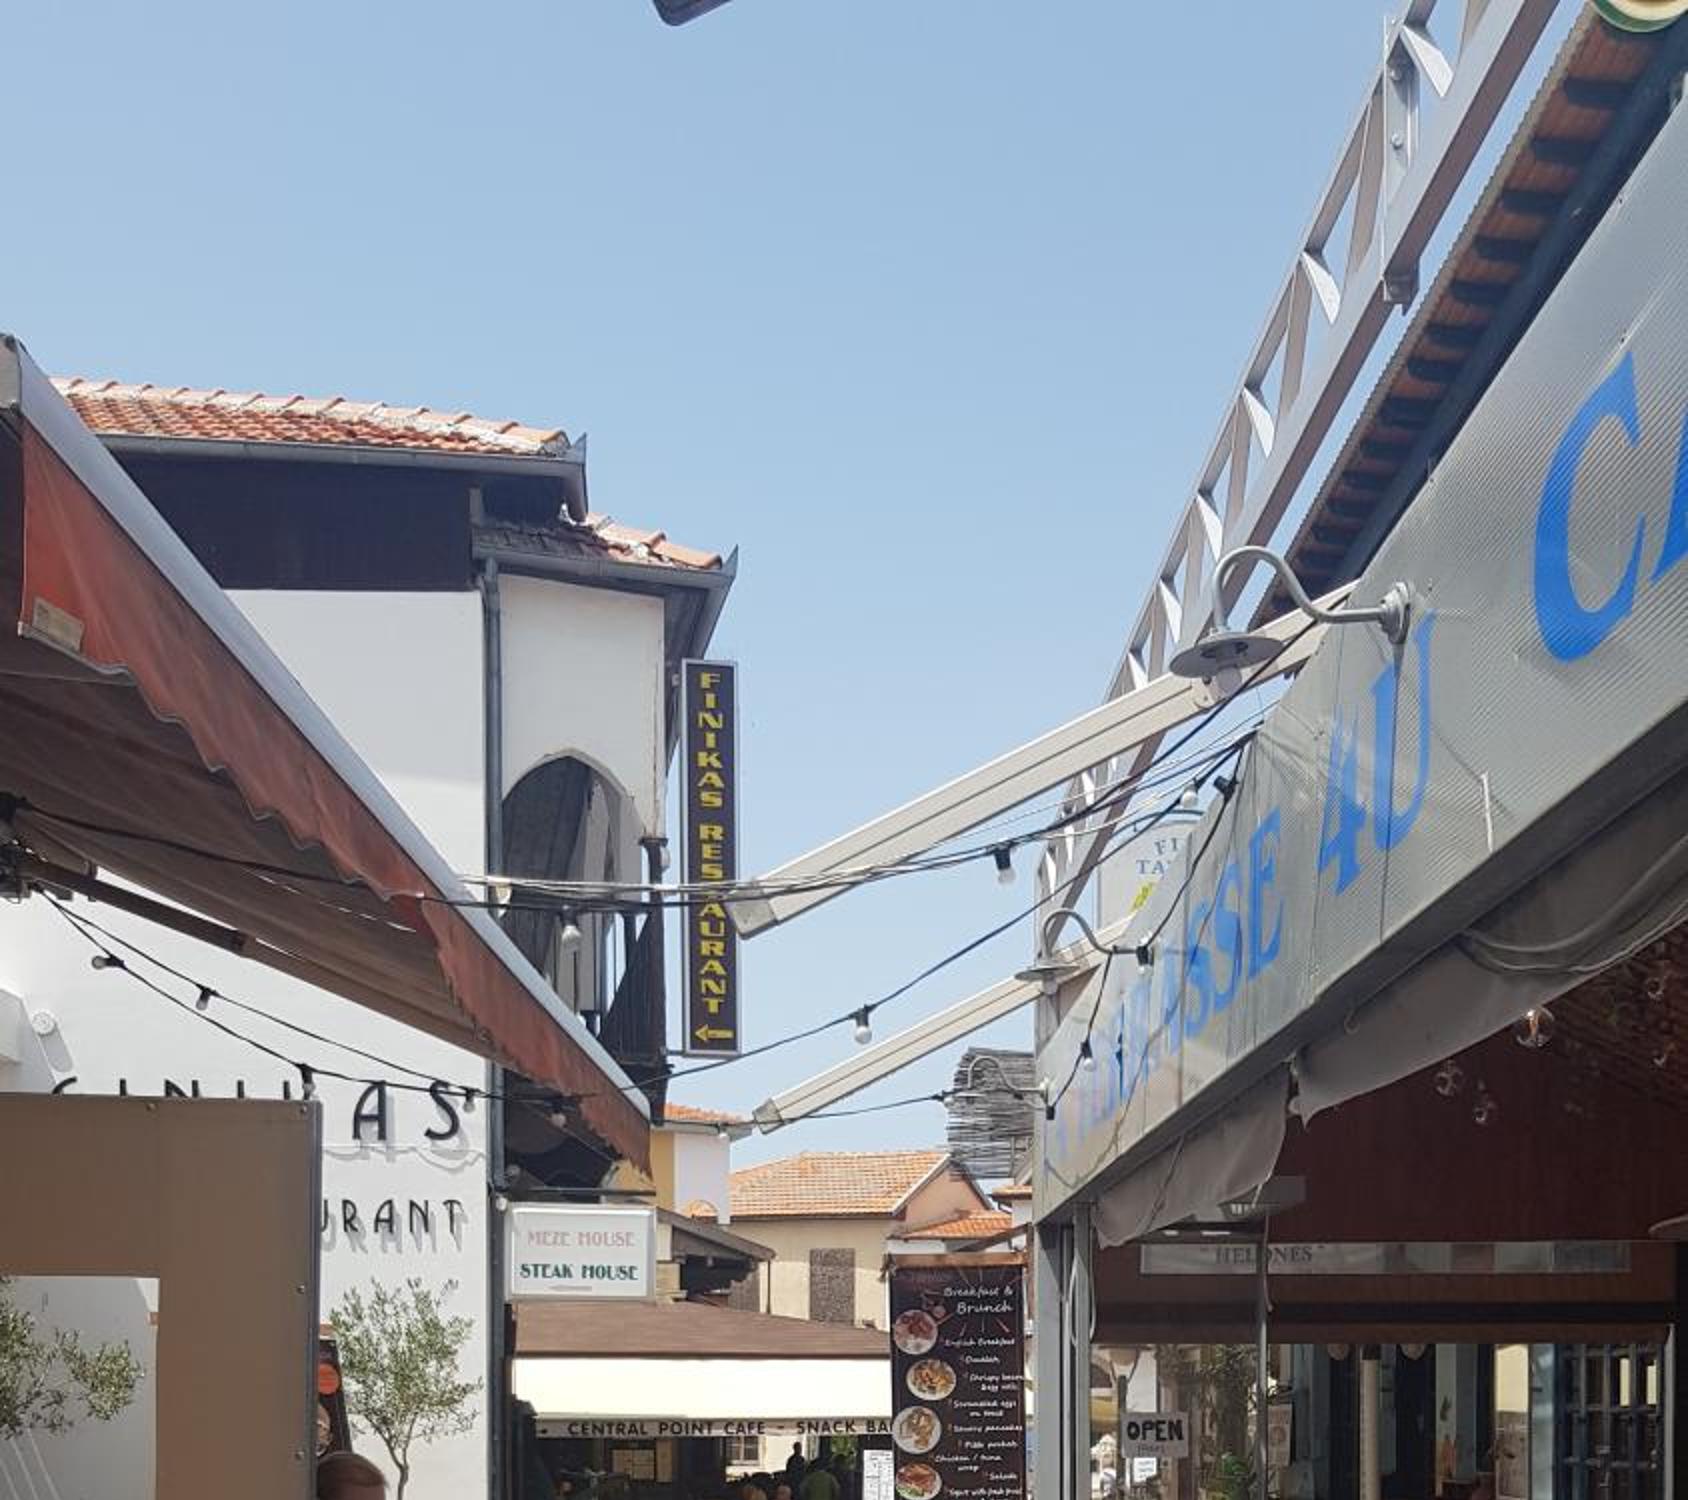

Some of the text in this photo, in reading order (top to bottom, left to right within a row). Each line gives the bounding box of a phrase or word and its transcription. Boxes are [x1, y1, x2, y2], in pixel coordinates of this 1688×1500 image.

[1316, 608, 1438, 896] 4U
[696, 671, 726, 1014] FINIKAS RESAURANT
[1136, 859, 1171, 876] TA
[528, 1231, 636, 1247] MEZE HOUSE
[520, 1263, 639, 1280] STEAK HOUSE
[943, 1285, 1014, 1298] Breakfast &
[957, 1300, 1014, 1315] Brunch
[567, 1421, 649, 1436] CENTRAL
[659, 1421, 713, 1435] POINT
[724, 1420, 765, 1435] CAFE
[796, 1420, 856, 1435] SNACK
[865, 1419, 894, 1434] BA
[1127, 1419, 1184, 1441] OPEN
